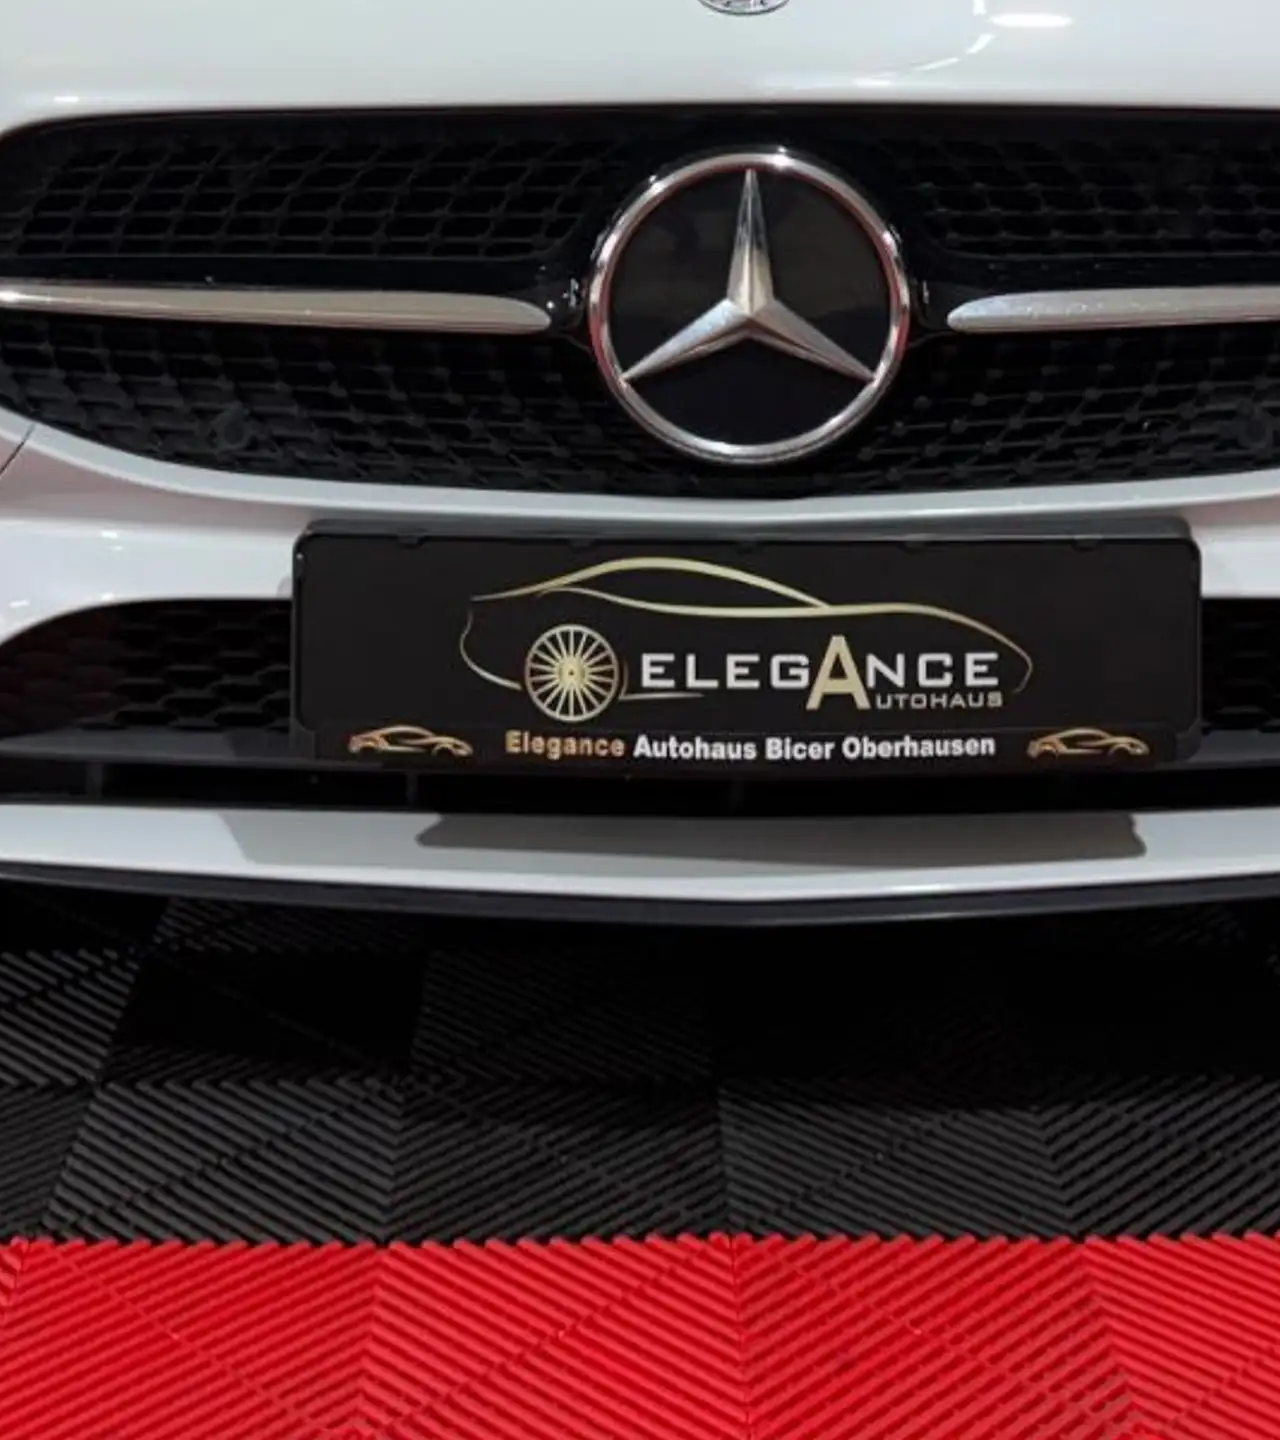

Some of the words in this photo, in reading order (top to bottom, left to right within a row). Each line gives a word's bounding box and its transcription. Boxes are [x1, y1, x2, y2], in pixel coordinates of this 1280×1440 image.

[640, 635, 1000, 711] ELEGANCE
[504, 729, 626, 761] Elegance
[632, 734, 757, 760] Autohaus
[765, 736, 836, 760] Bicer
[841, 735, 996, 760] Oberhausen
